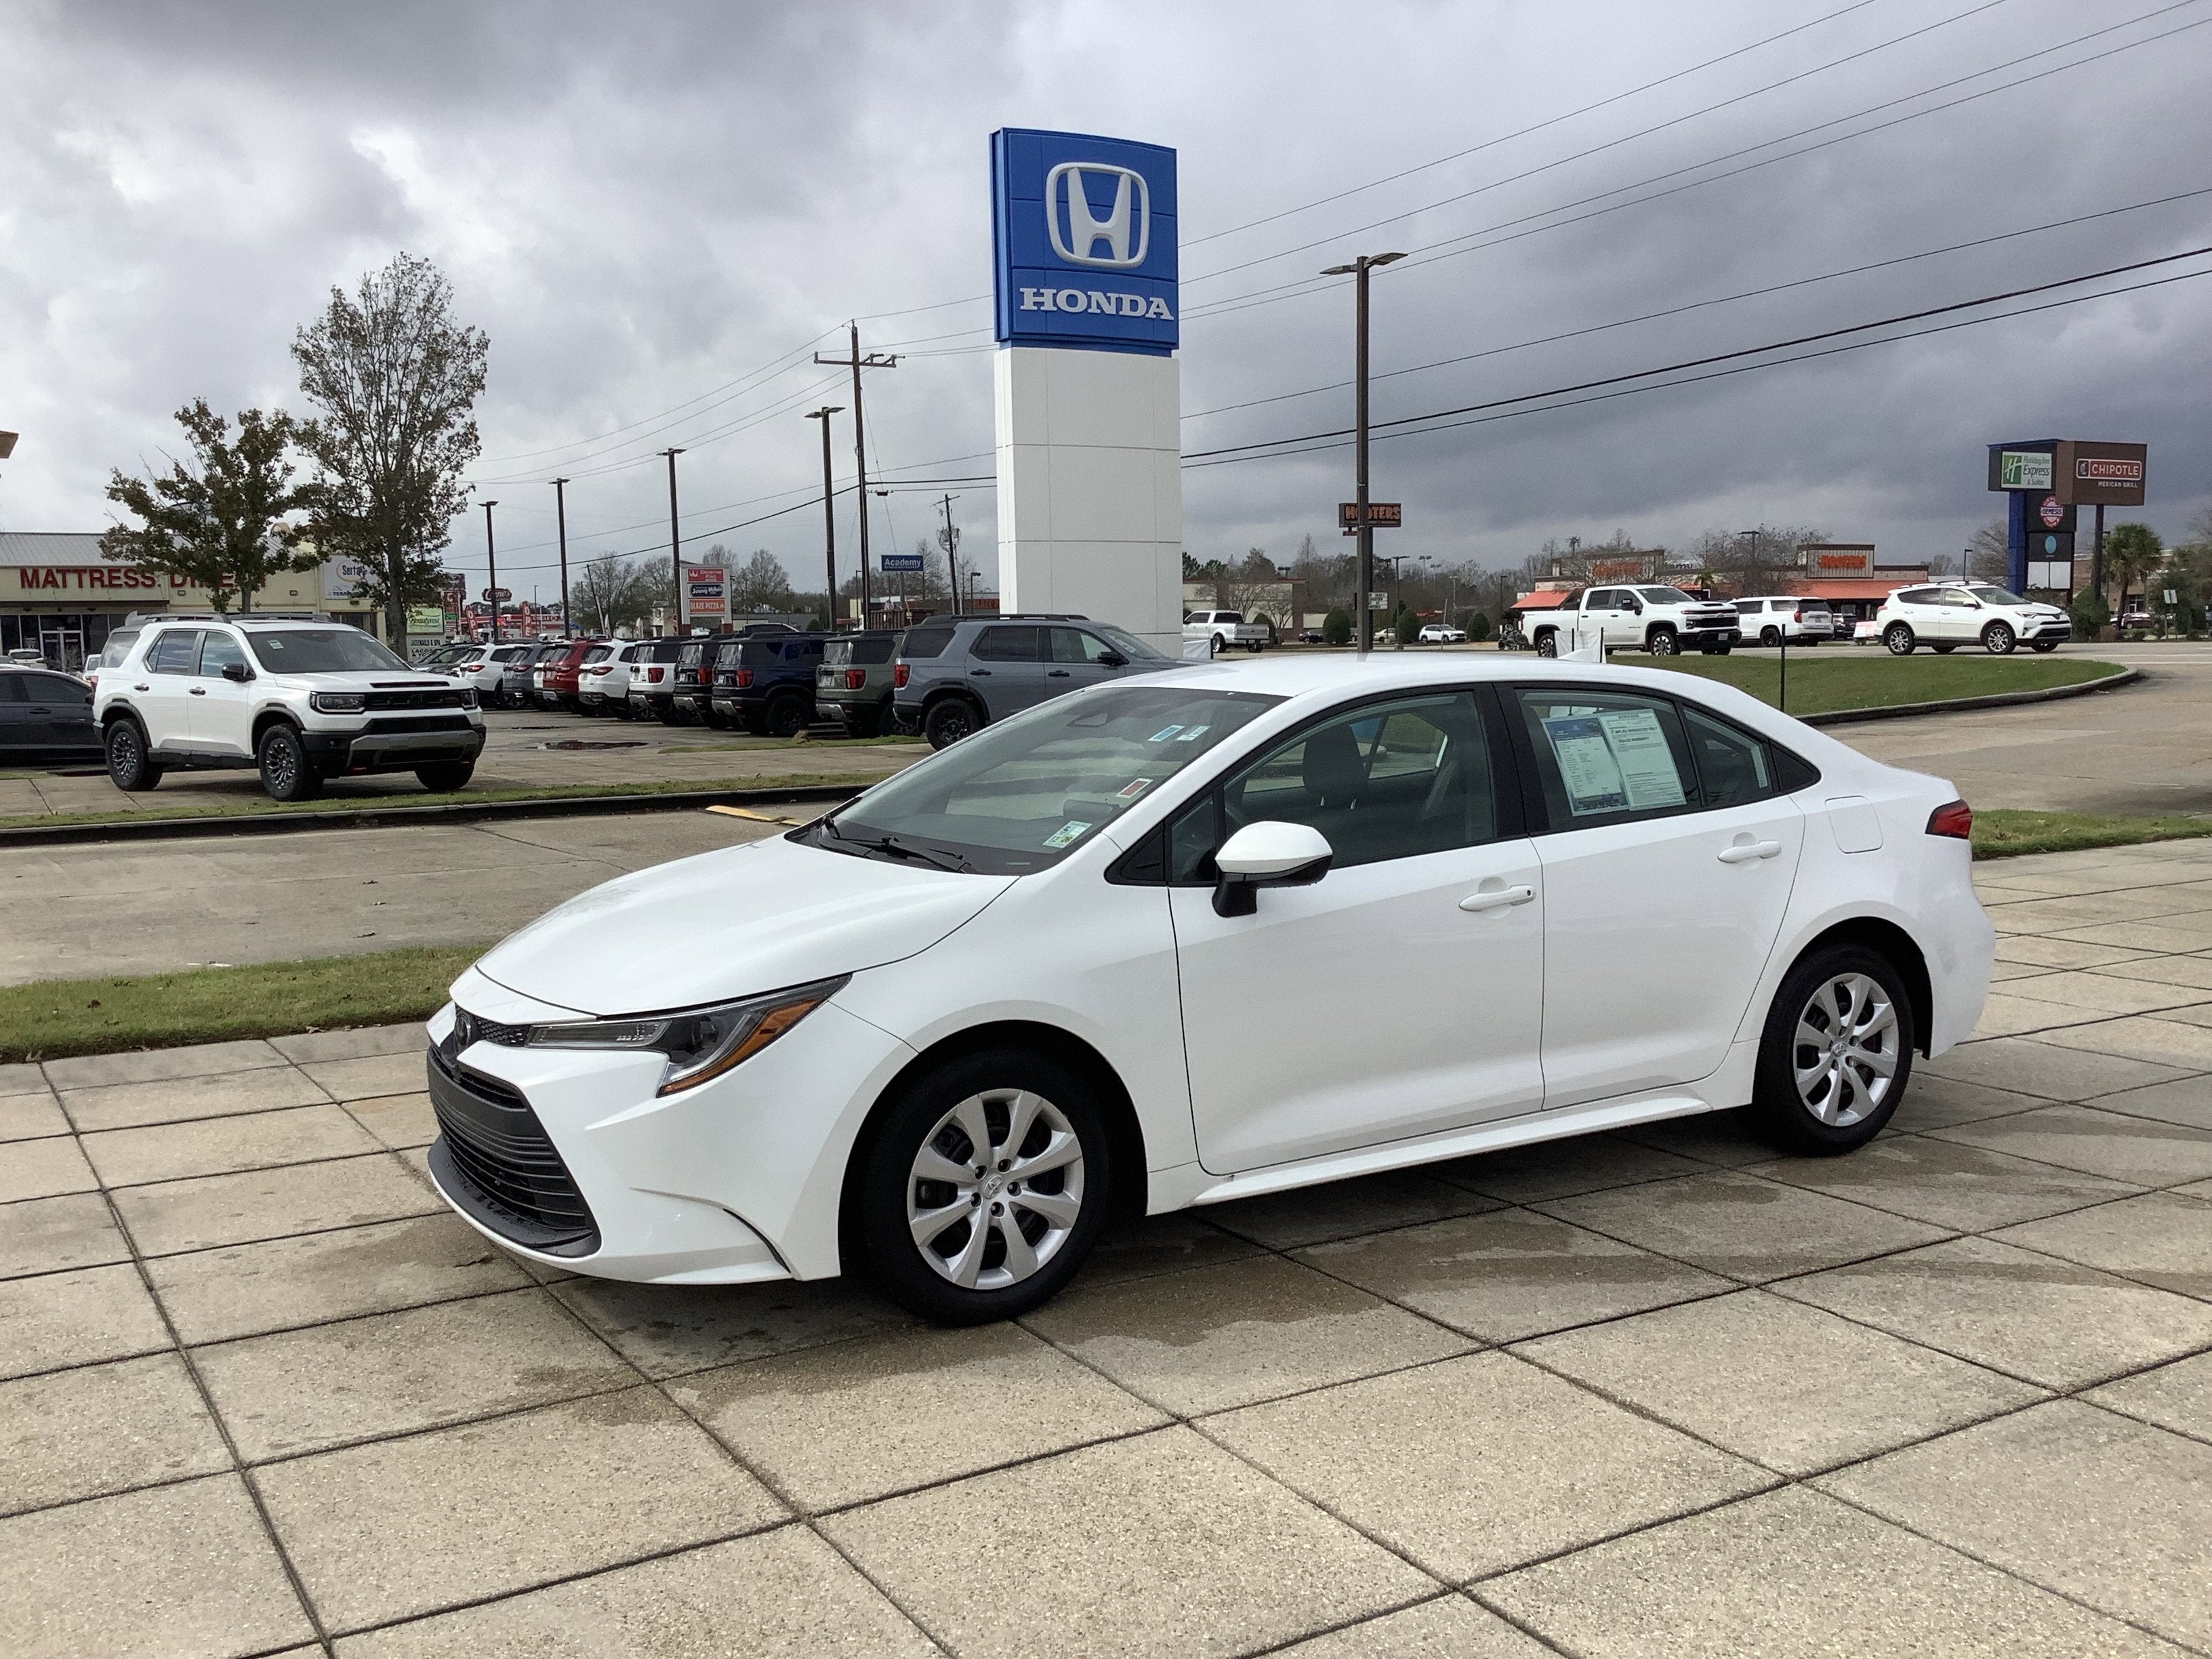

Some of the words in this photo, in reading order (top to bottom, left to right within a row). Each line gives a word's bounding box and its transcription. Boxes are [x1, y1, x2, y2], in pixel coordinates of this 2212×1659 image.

[1020, 287, 1174, 321] HONDA
[2023, 464, 2050, 478] Express
[2092, 464, 2139, 476] CHIPOTLE
[1345, 506, 1400, 520] HOTERS
[884, 558, 922, 569] Academy
[20, 568, 156, 589] MATTRESS
